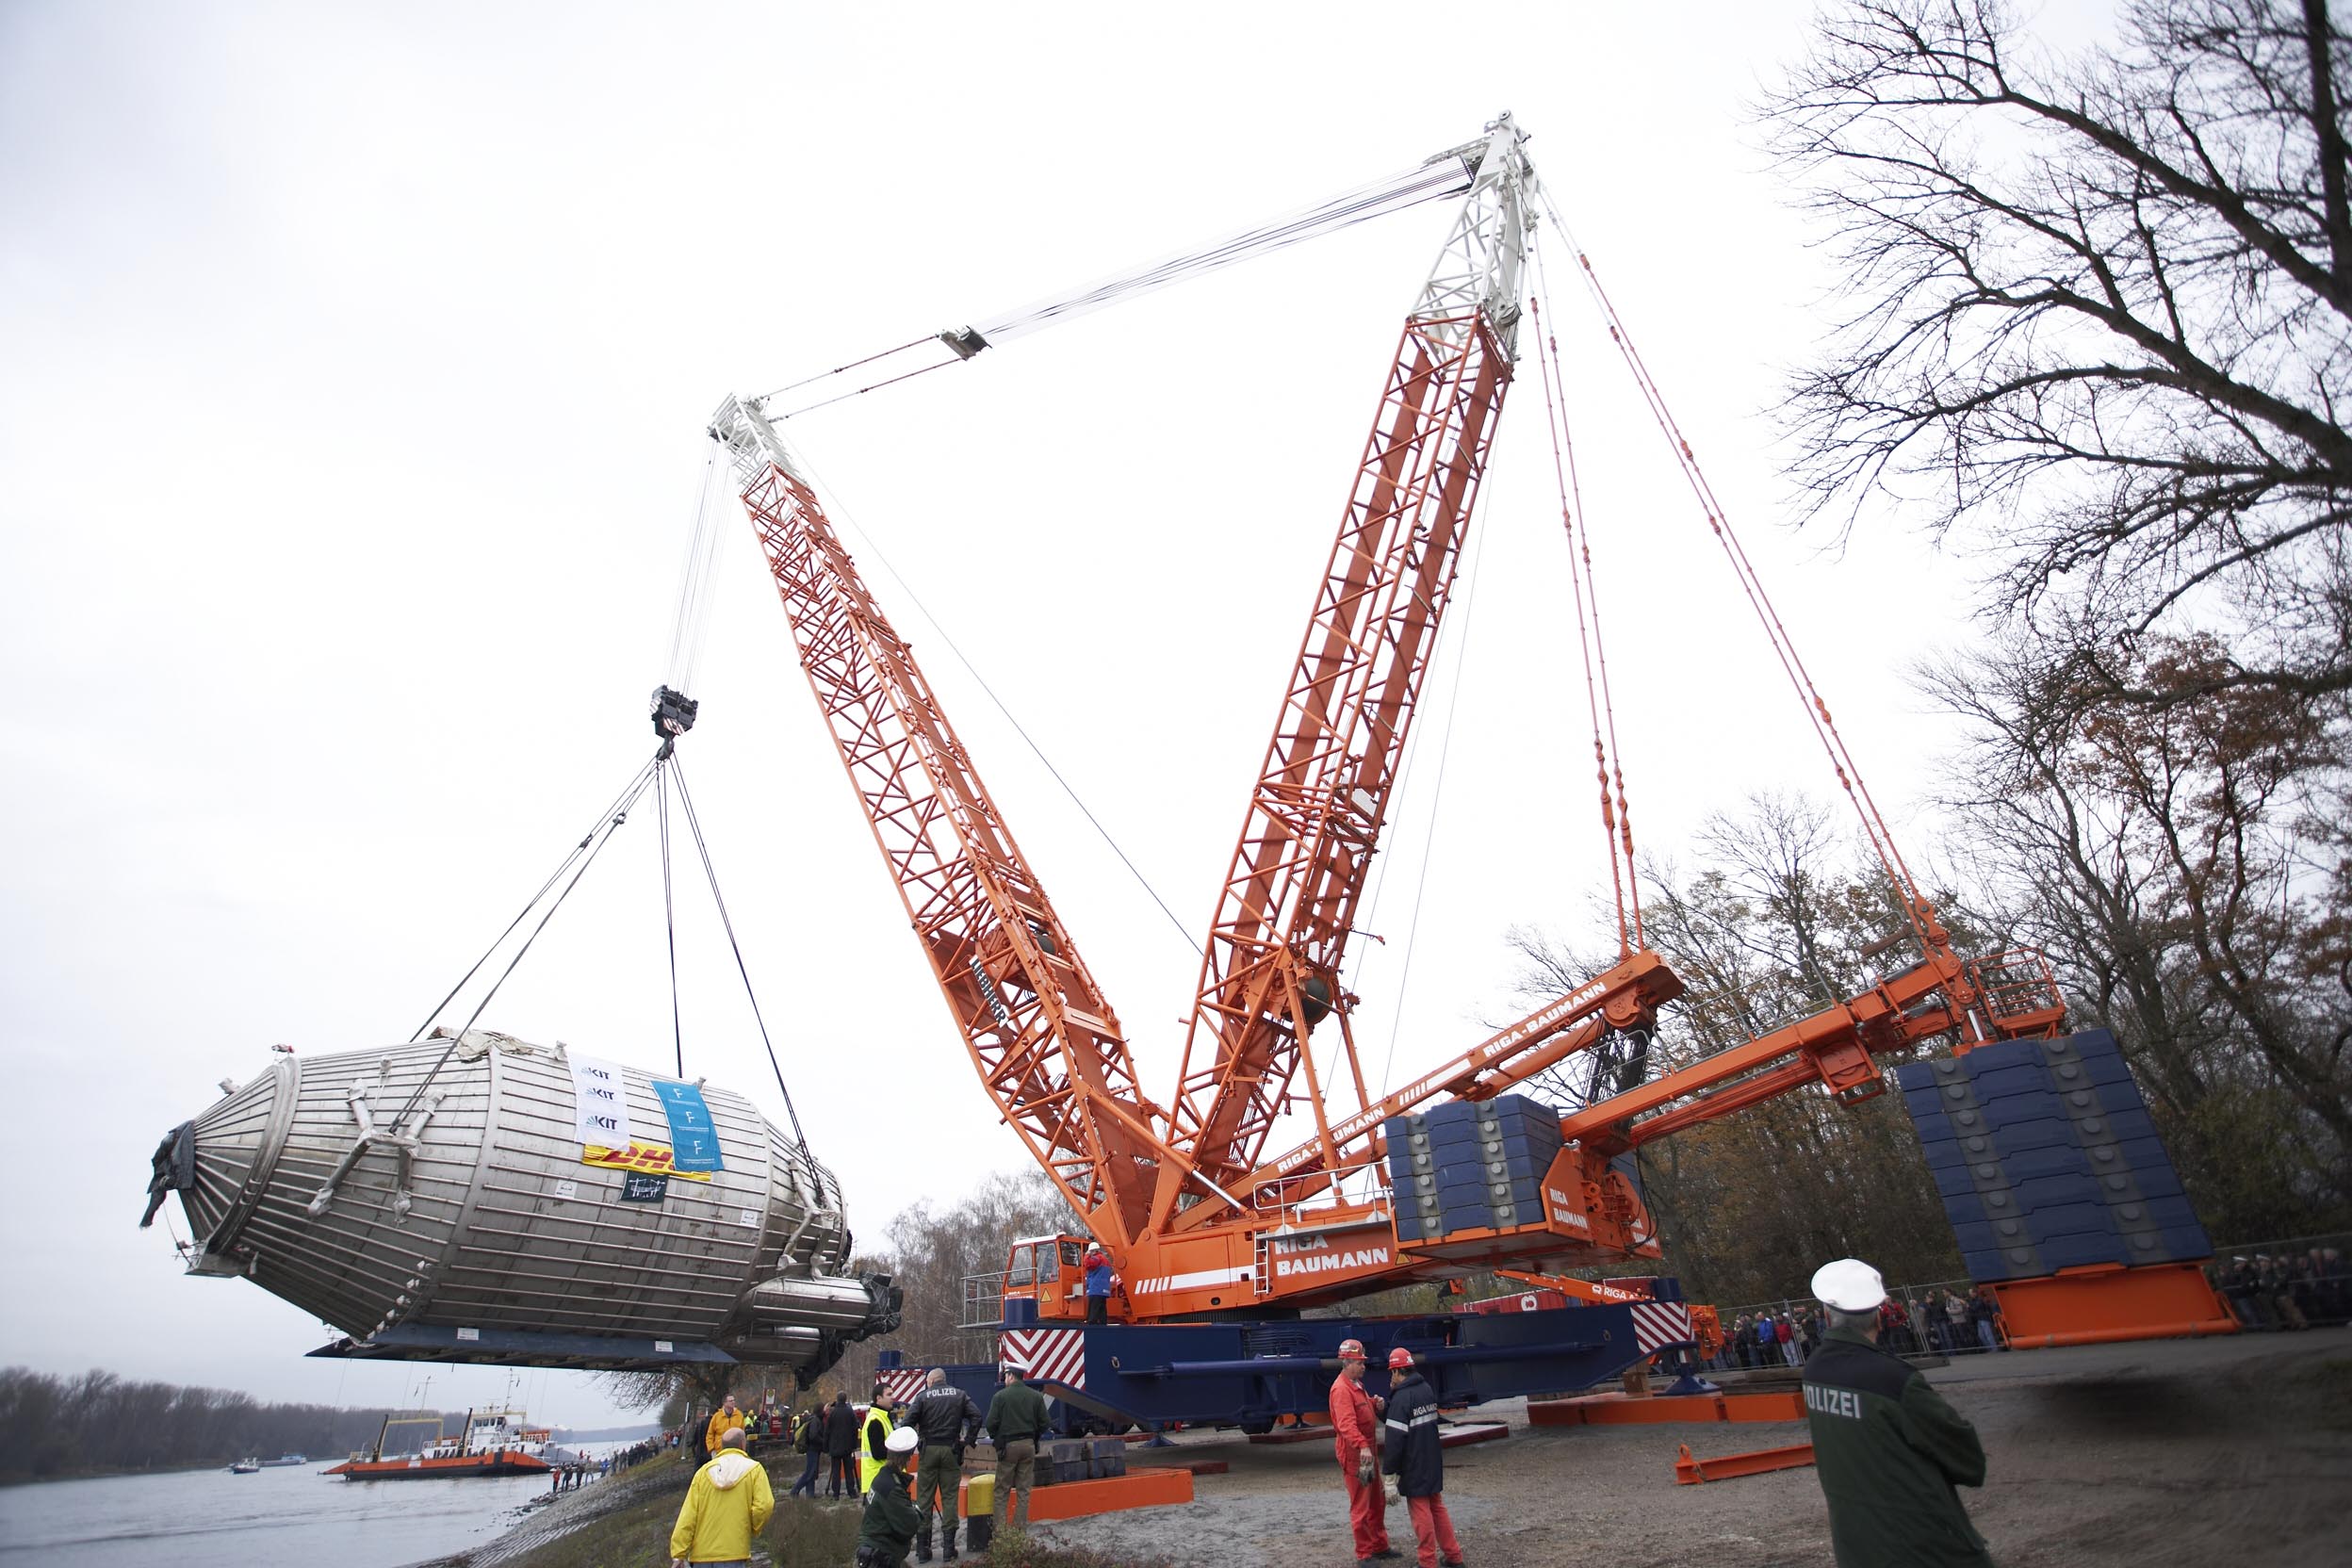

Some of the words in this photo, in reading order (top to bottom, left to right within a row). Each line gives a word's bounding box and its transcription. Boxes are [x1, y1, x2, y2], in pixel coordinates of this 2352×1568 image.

[1483, 982, 1607, 1057] RIGA-BAUMANN
[588, 1068, 610, 1080] KIT
[593, 1087, 614, 1101] KIT
[595, 1116, 617, 1130] KIT
[602, 1146, 675, 1170] DH
[1549, 1188, 1569, 1205] RIGA
[1553, 1207, 1588, 1229] BAUMANN
[1275, 1234, 1329, 1255] RIGA
[1277, 1248, 1389, 1277] BAUMANN
[1604, 1287, 1627, 1300] RIGA
[926, 1387, 956, 1398] POLIZEI
